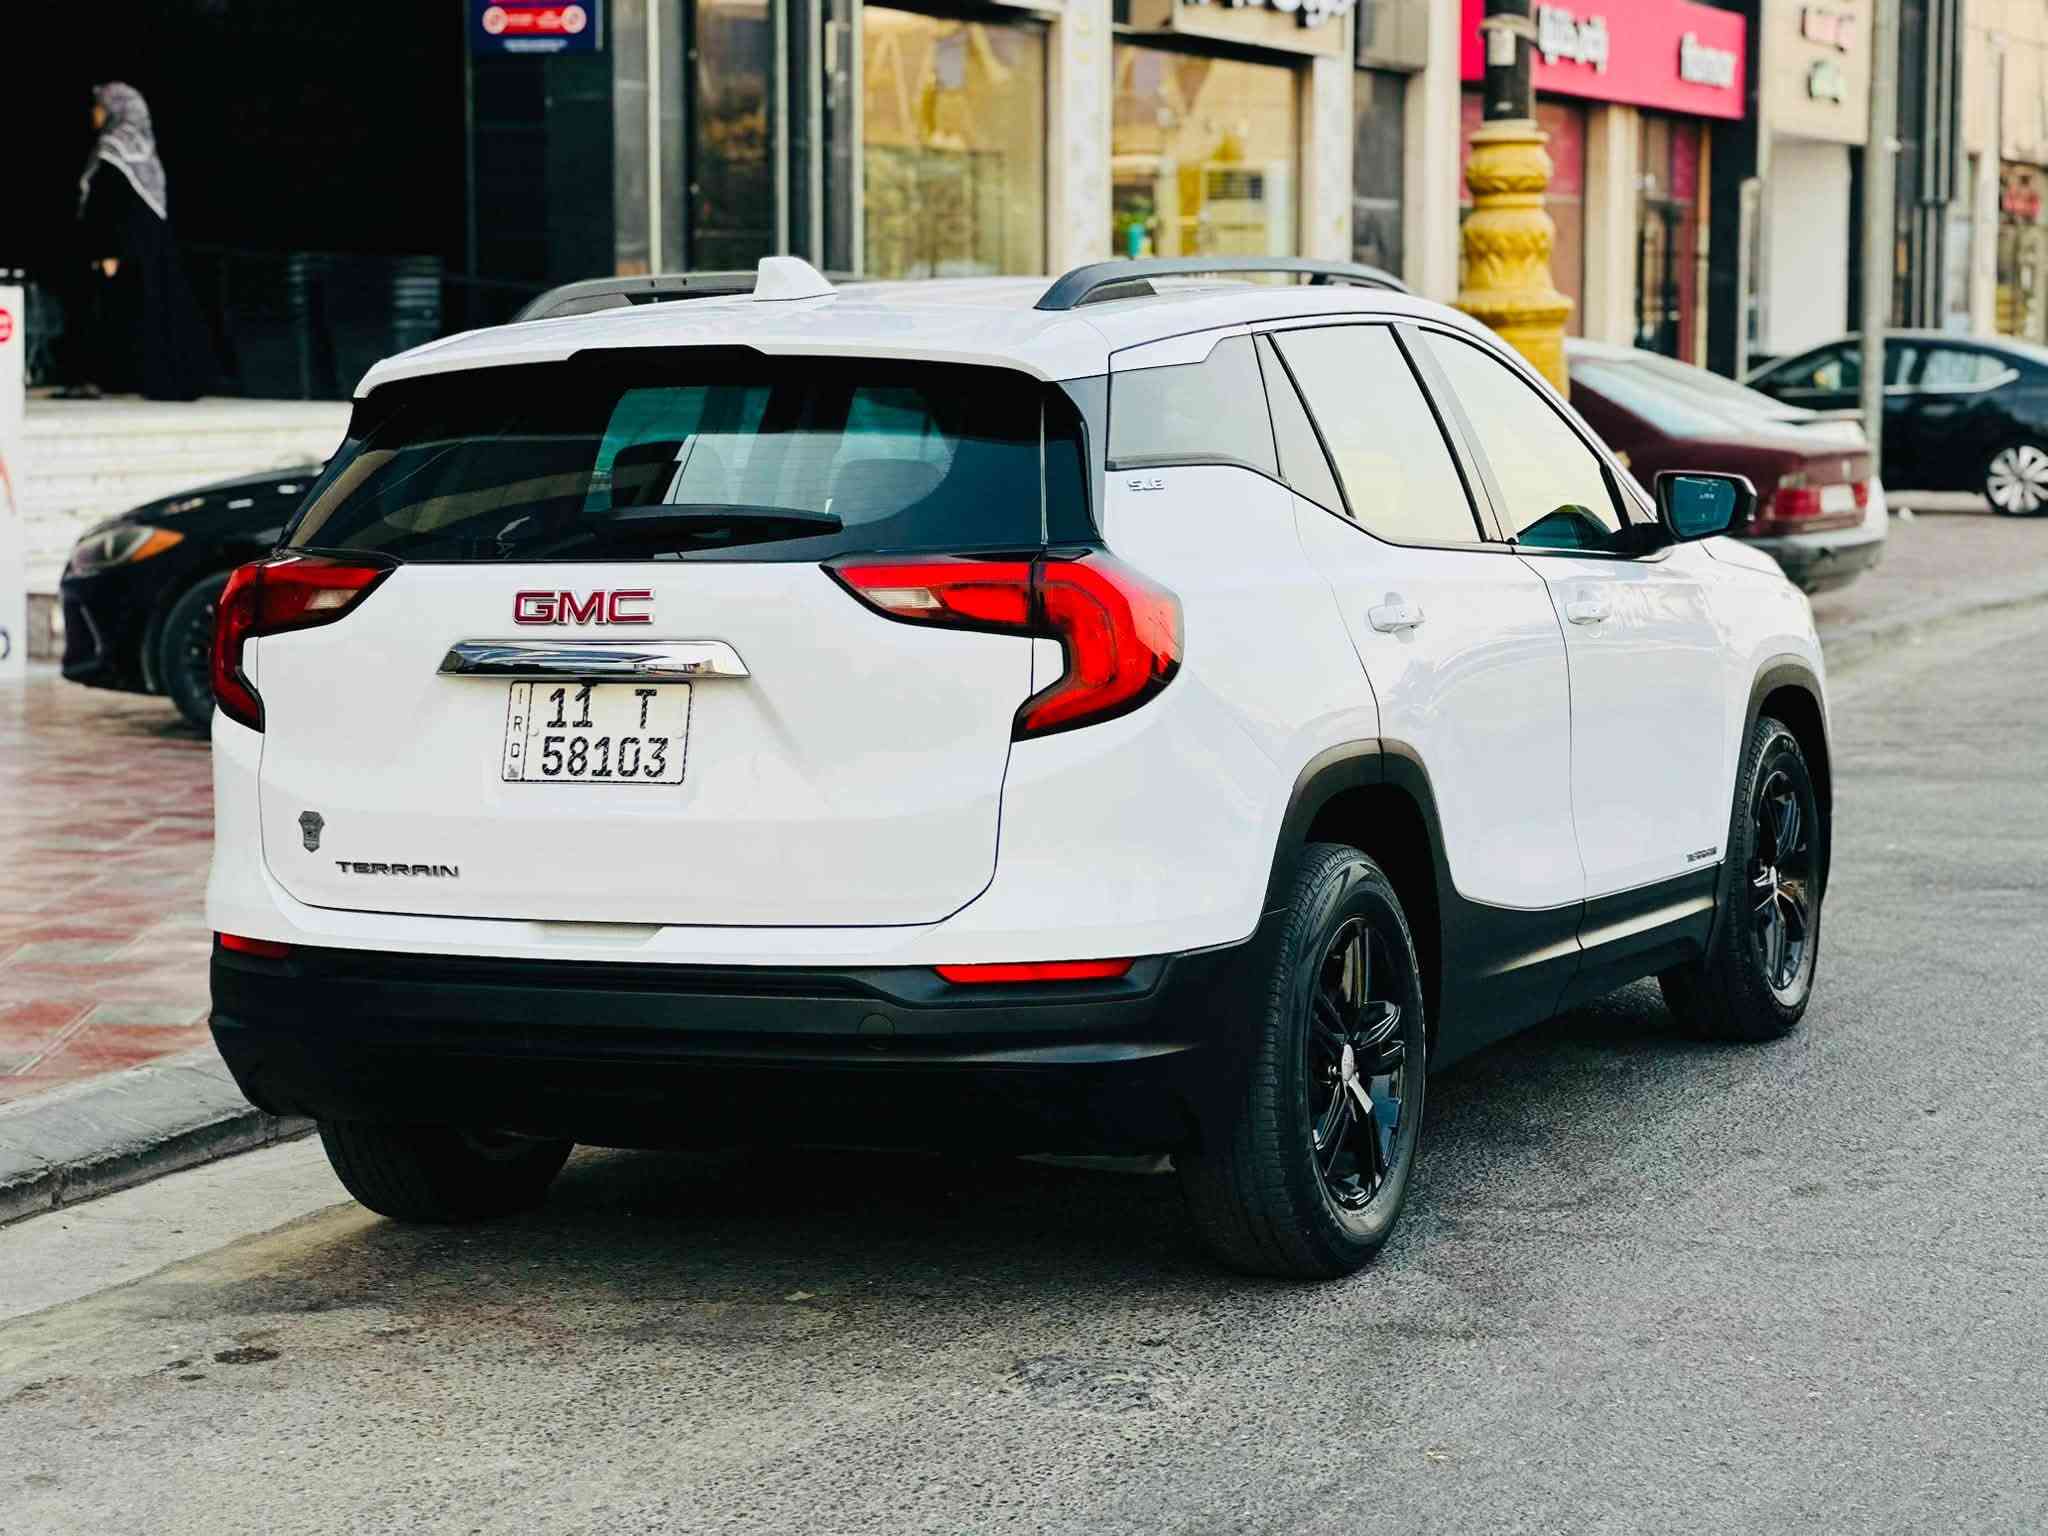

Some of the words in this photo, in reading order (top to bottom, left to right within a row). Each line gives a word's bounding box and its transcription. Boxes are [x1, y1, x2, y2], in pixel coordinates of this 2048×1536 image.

[512, 588, 655, 626] GMC
[546, 687, 593, 728] 11
[634, 688, 658, 729] T
[541, 736, 669, 778] 58103
[335, 860, 460, 878] TERRAIN
